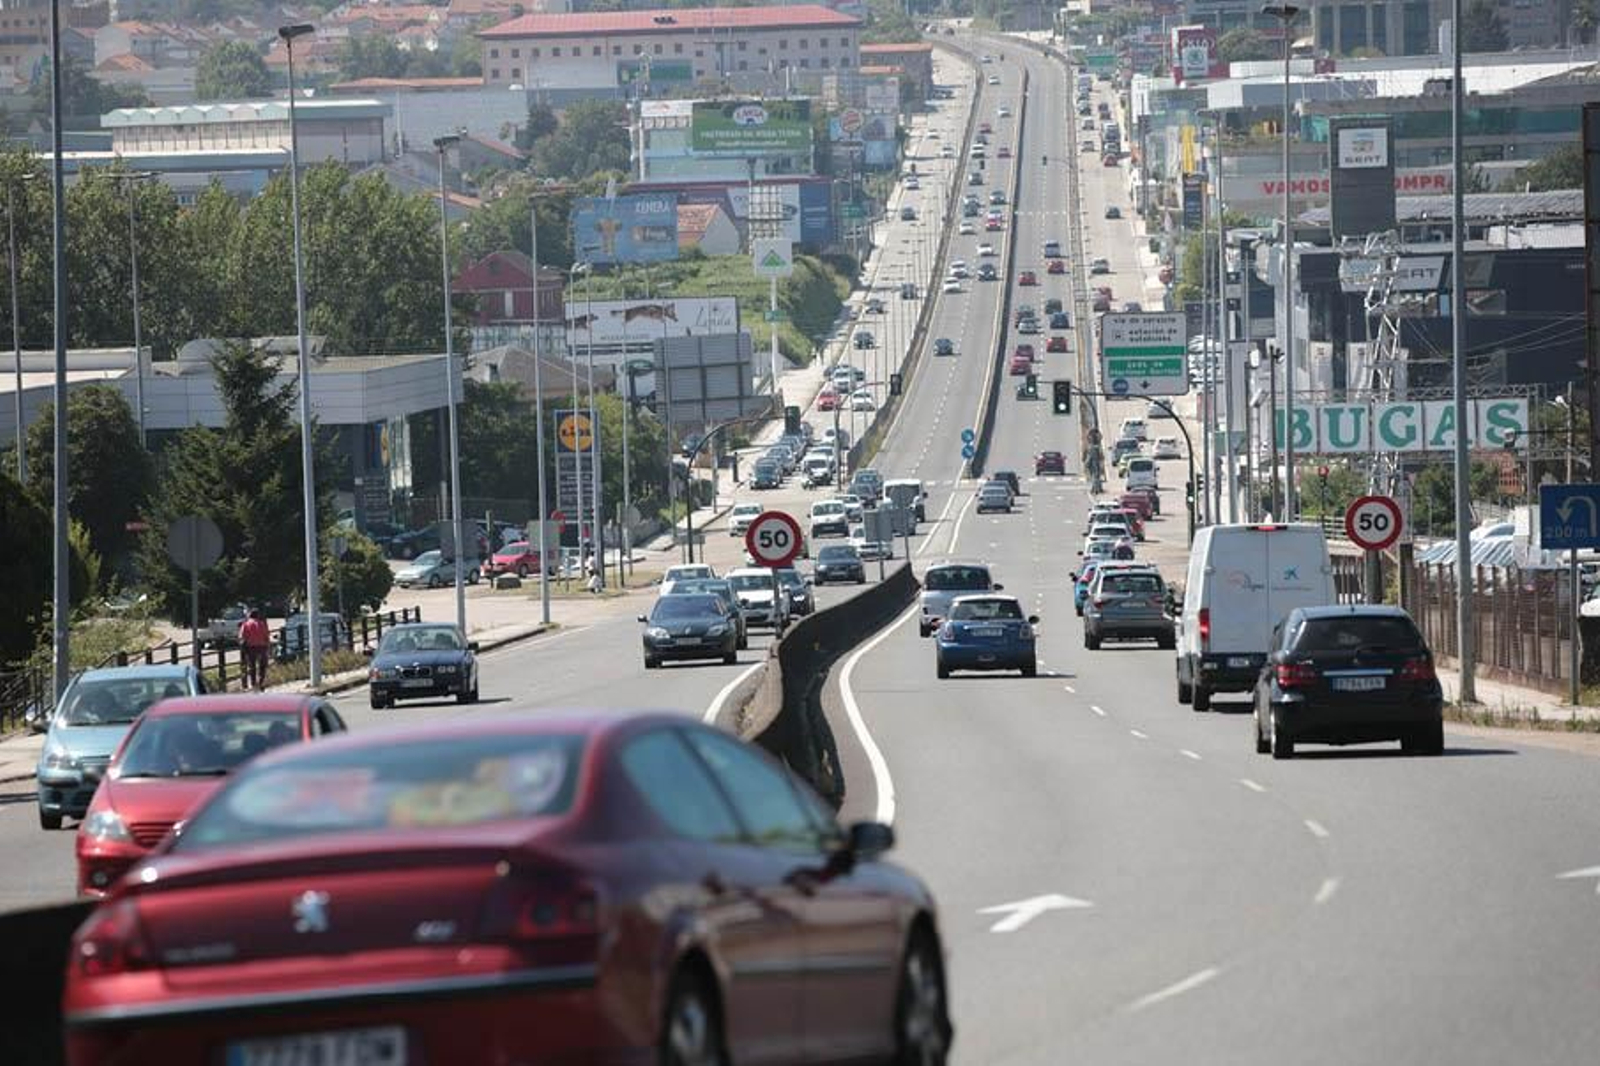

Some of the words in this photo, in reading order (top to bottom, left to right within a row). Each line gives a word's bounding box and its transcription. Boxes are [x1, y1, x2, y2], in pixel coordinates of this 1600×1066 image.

[1397, 267, 1439, 279] EAT
[1275, 402, 1522, 449] BUGAS
[1358, 513, 1389, 532] 50
[1543, 525, 1572, 539] 200
[759, 529, 789, 549] 50
